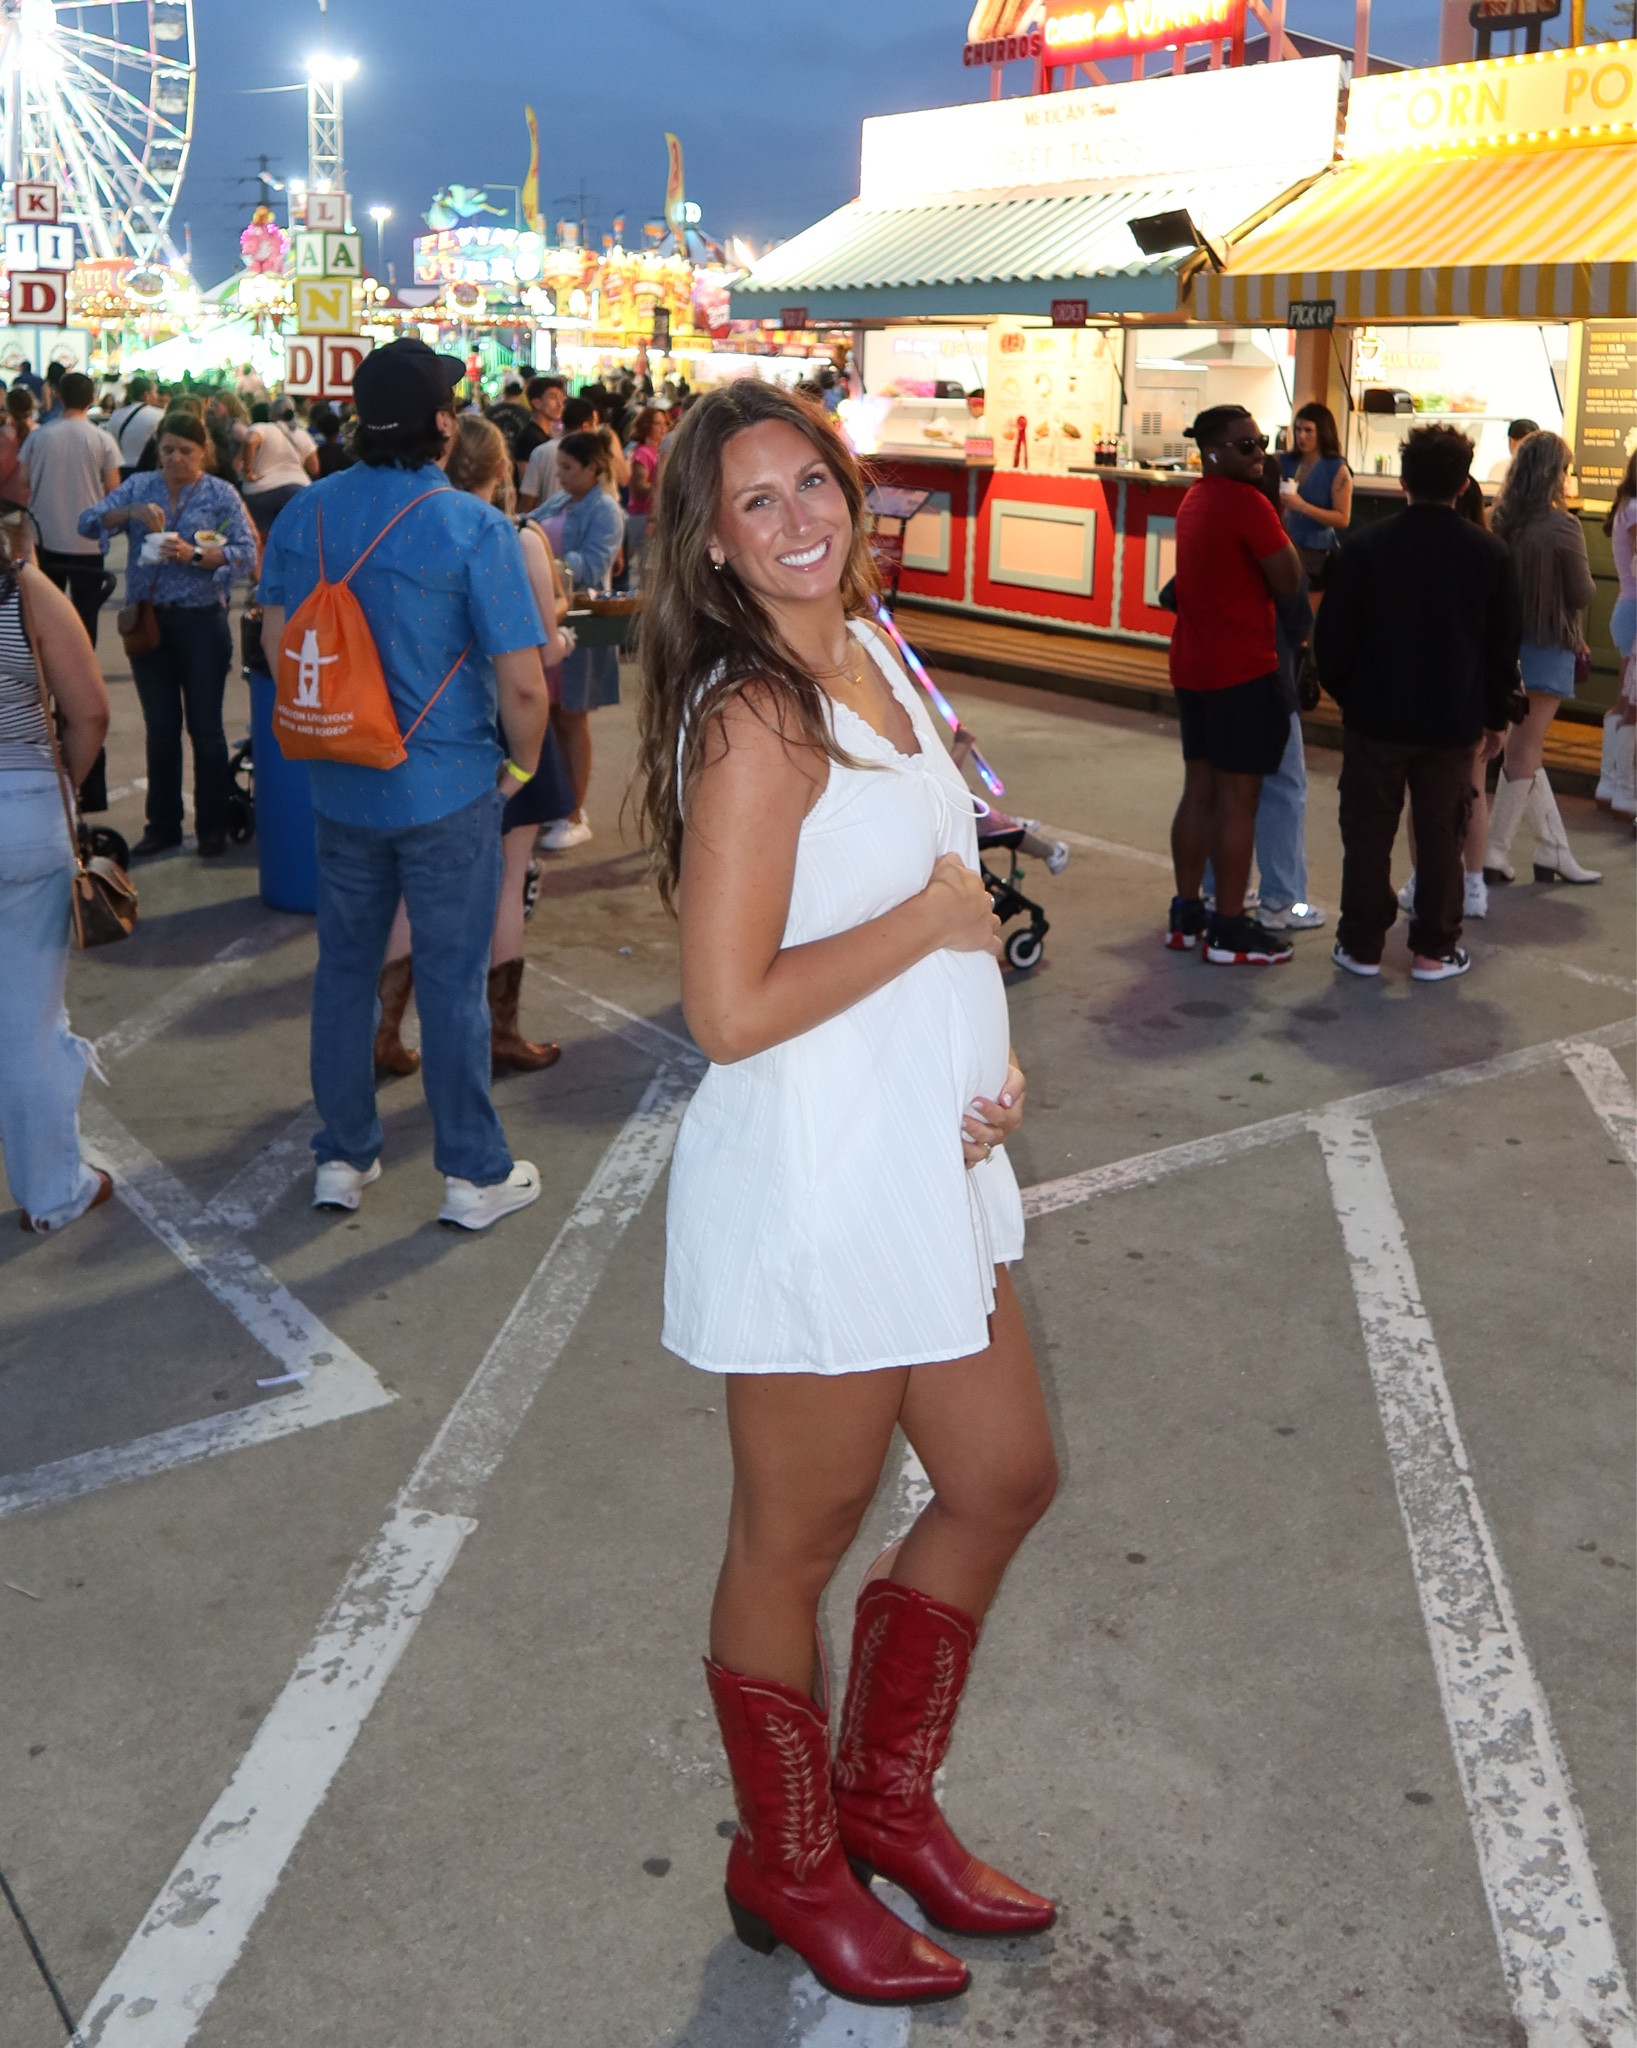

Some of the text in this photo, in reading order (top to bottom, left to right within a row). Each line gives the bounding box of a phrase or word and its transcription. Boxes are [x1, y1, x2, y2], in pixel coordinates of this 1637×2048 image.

[963, 32, 1041, 67] CHURROS
[1024, 103, 1086, 126] MEXICAN
[1373, 78, 1508, 135] CORN
[1070, 136, 1146, 168] TACOS
[1289, 304, 1334, 326] PICK UP
